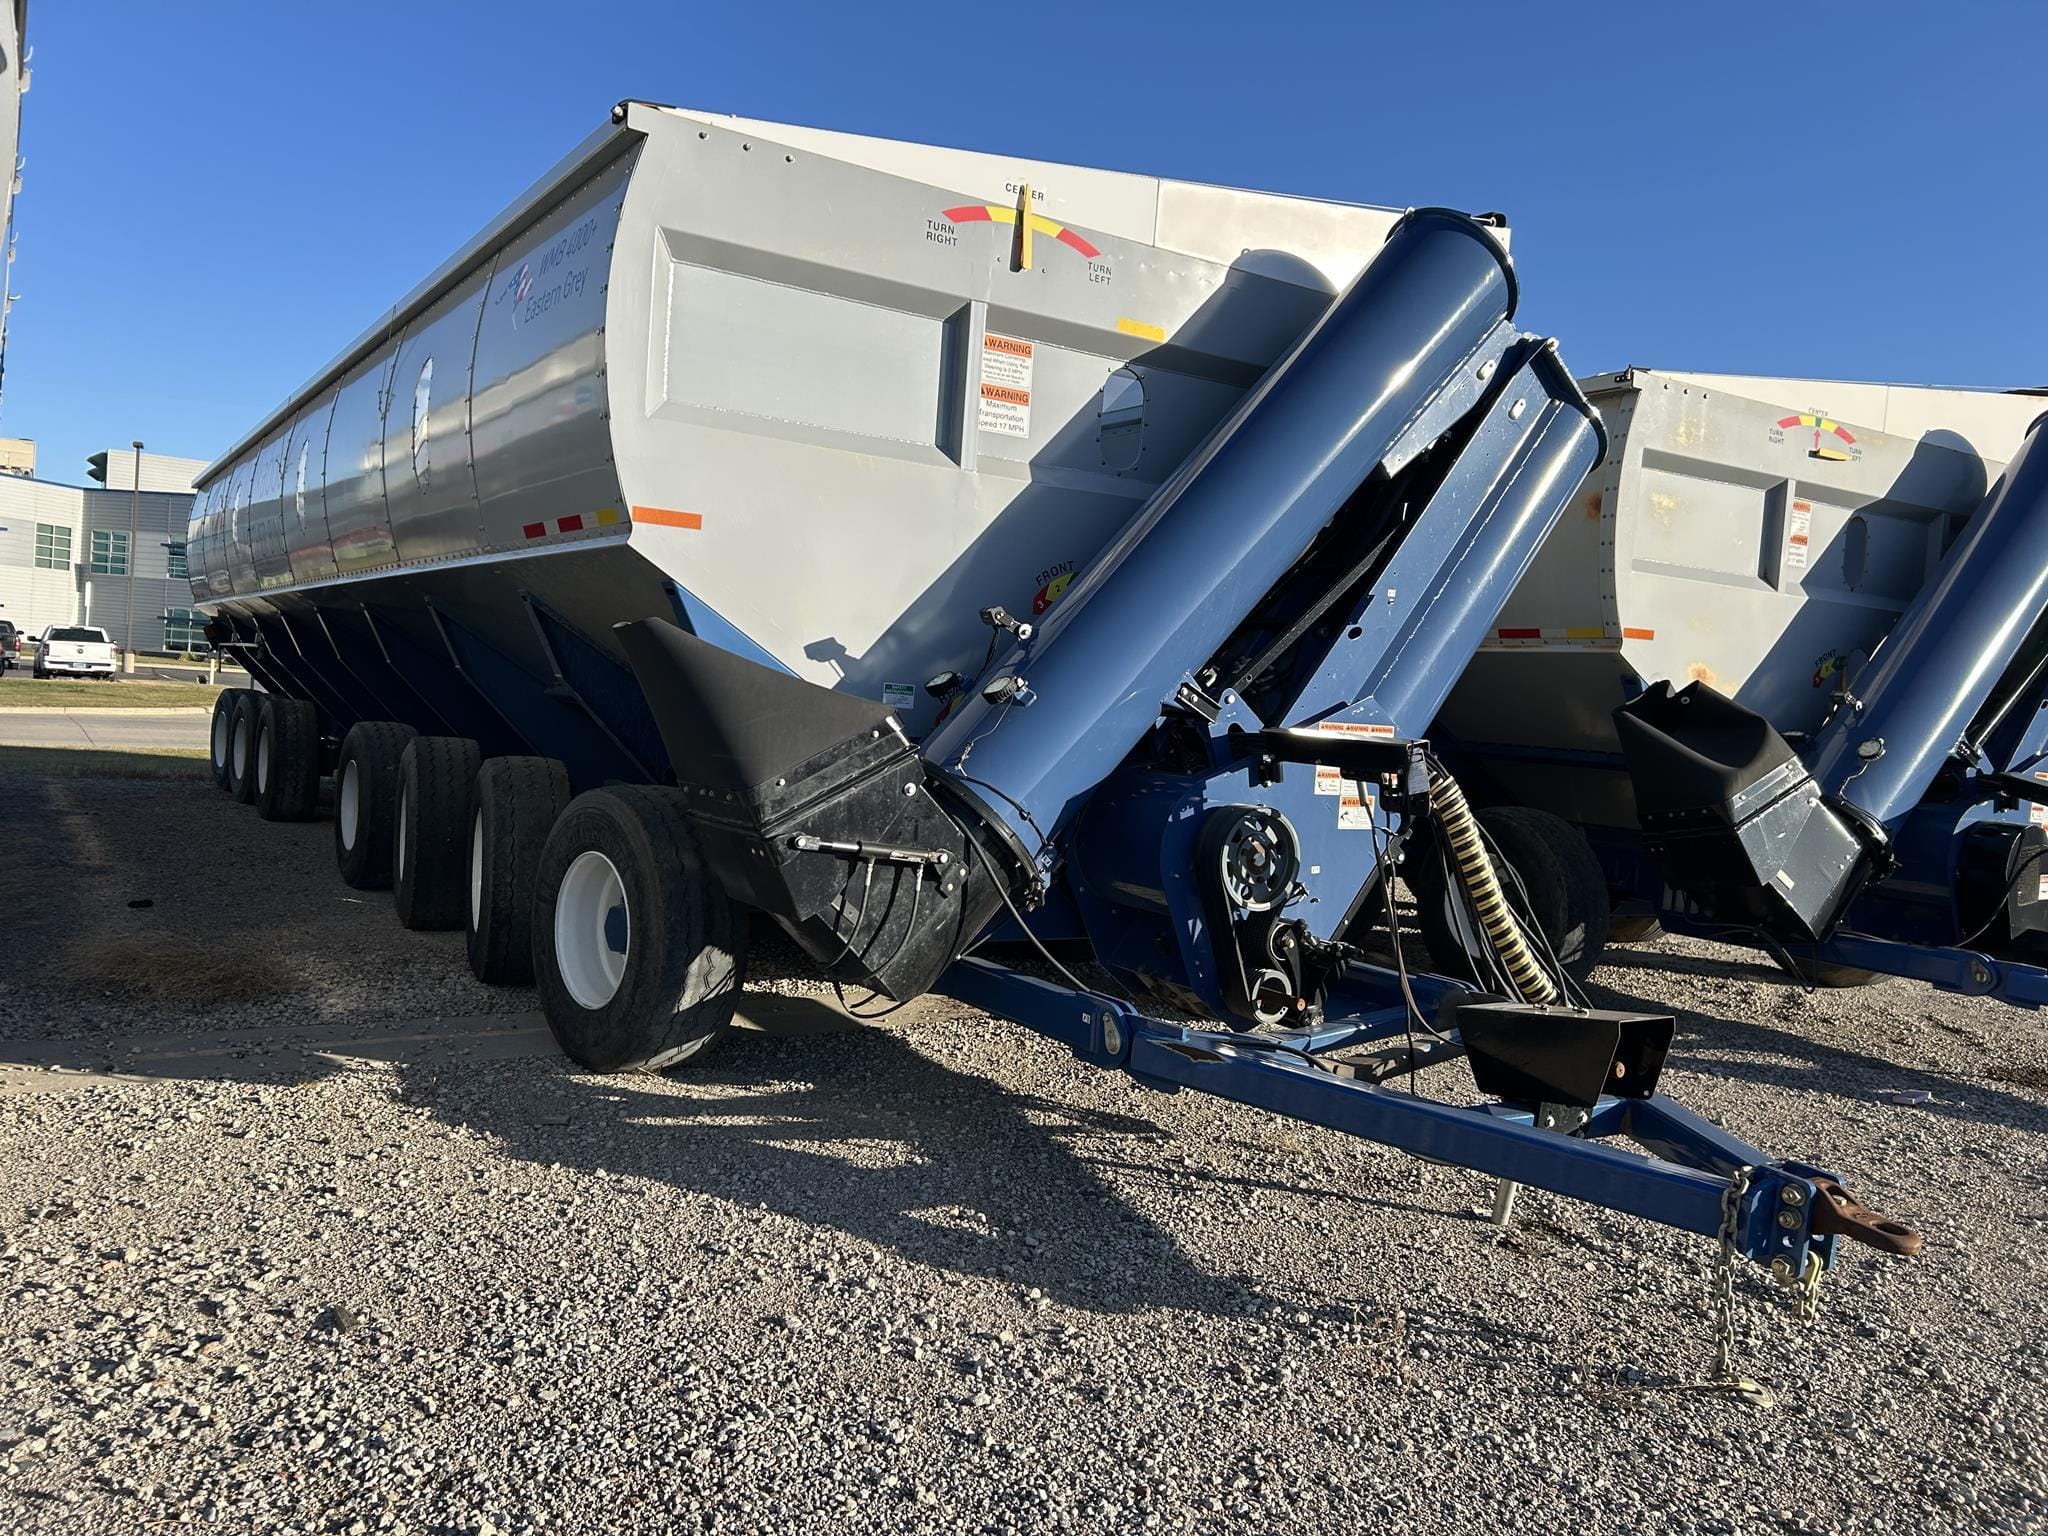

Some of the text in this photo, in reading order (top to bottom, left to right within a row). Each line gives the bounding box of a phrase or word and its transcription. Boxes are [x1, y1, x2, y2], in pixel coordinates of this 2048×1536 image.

[1005, 183, 1044, 201] CENER
[926, 219, 955, 235] TURN
[926, 232, 958, 247] RIGHT
[539, 239, 567, 277] WMB
[1087, 261, 1112, 276] TURN
[1089, 272, 1112, 286] LEFT
[524, 265, 589, 323] Eastern Grey
[988, 337, 1031, 355] WARNING
[986, 387, 1029, 403] WARNING
[986, 400, 1017, 411] Maximum
[1808, 408, 1829, 416] CENTER
[979, 408, 1024, 423] Transportation
[999, 422, 1007, 430] 17
[1008, 424, 1025, 433] MPH
[1769, 428, 1783, 437] TURN
[1768, 436, 1784, 445] RIGHT
[1849, 447, 1862, 455] TURN
[1036, 560, 1074, 586] FRONT
[1055, 584, 1062, 592] 2
[1038, 600, 1044, 609] 3
